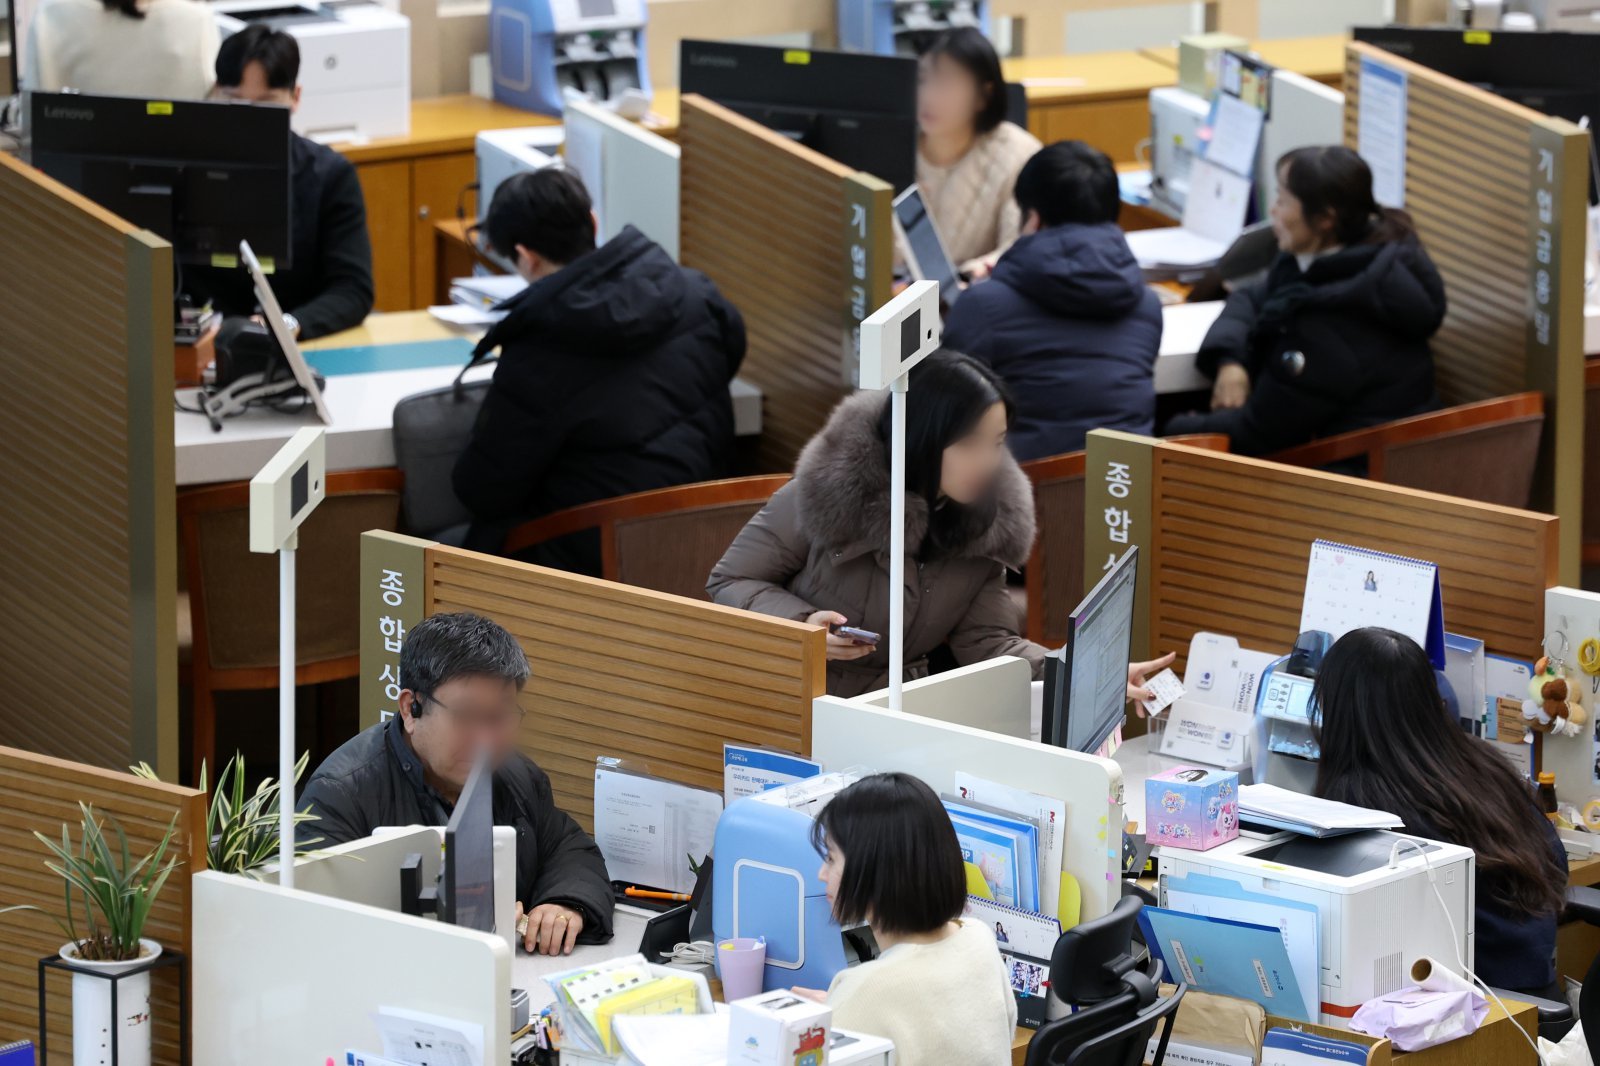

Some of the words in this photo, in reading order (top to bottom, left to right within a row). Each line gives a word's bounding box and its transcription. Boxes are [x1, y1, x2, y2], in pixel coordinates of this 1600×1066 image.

[43, 105, 95, 121] Lenovo
[1103, 462, 1132, 571] 종합
[379, 569, 406, 724] 종합상
